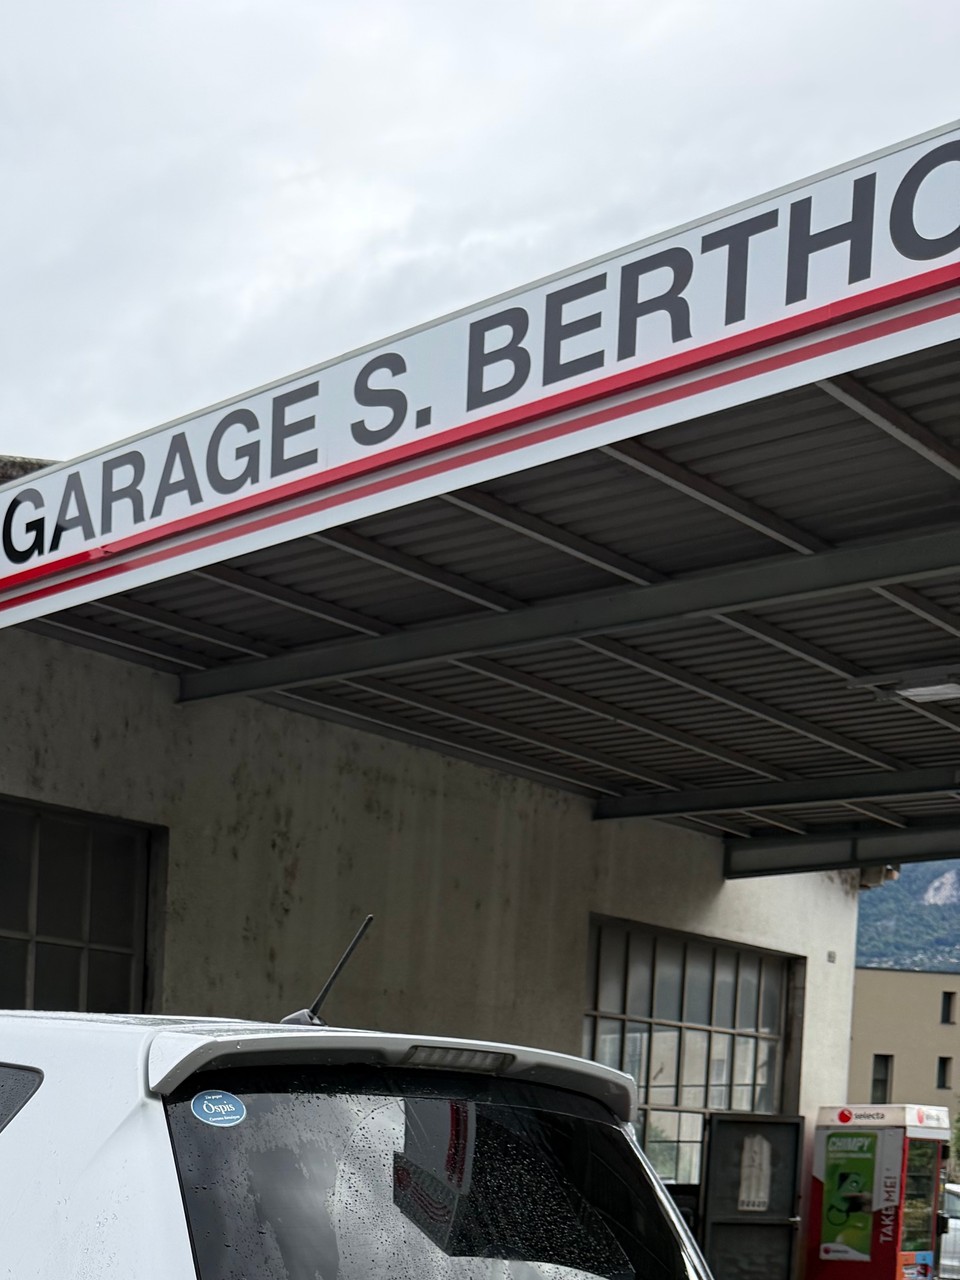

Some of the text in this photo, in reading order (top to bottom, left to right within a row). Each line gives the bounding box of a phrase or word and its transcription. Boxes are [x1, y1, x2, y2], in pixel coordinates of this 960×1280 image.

[3, 139, 960, 565] GARAGE S. BERTHO
[854, 1112, 885, 1120] selecta
[828, 1137, 871, 1151] CHIMPY
[880, 1206, 895, 1244] TAKE
